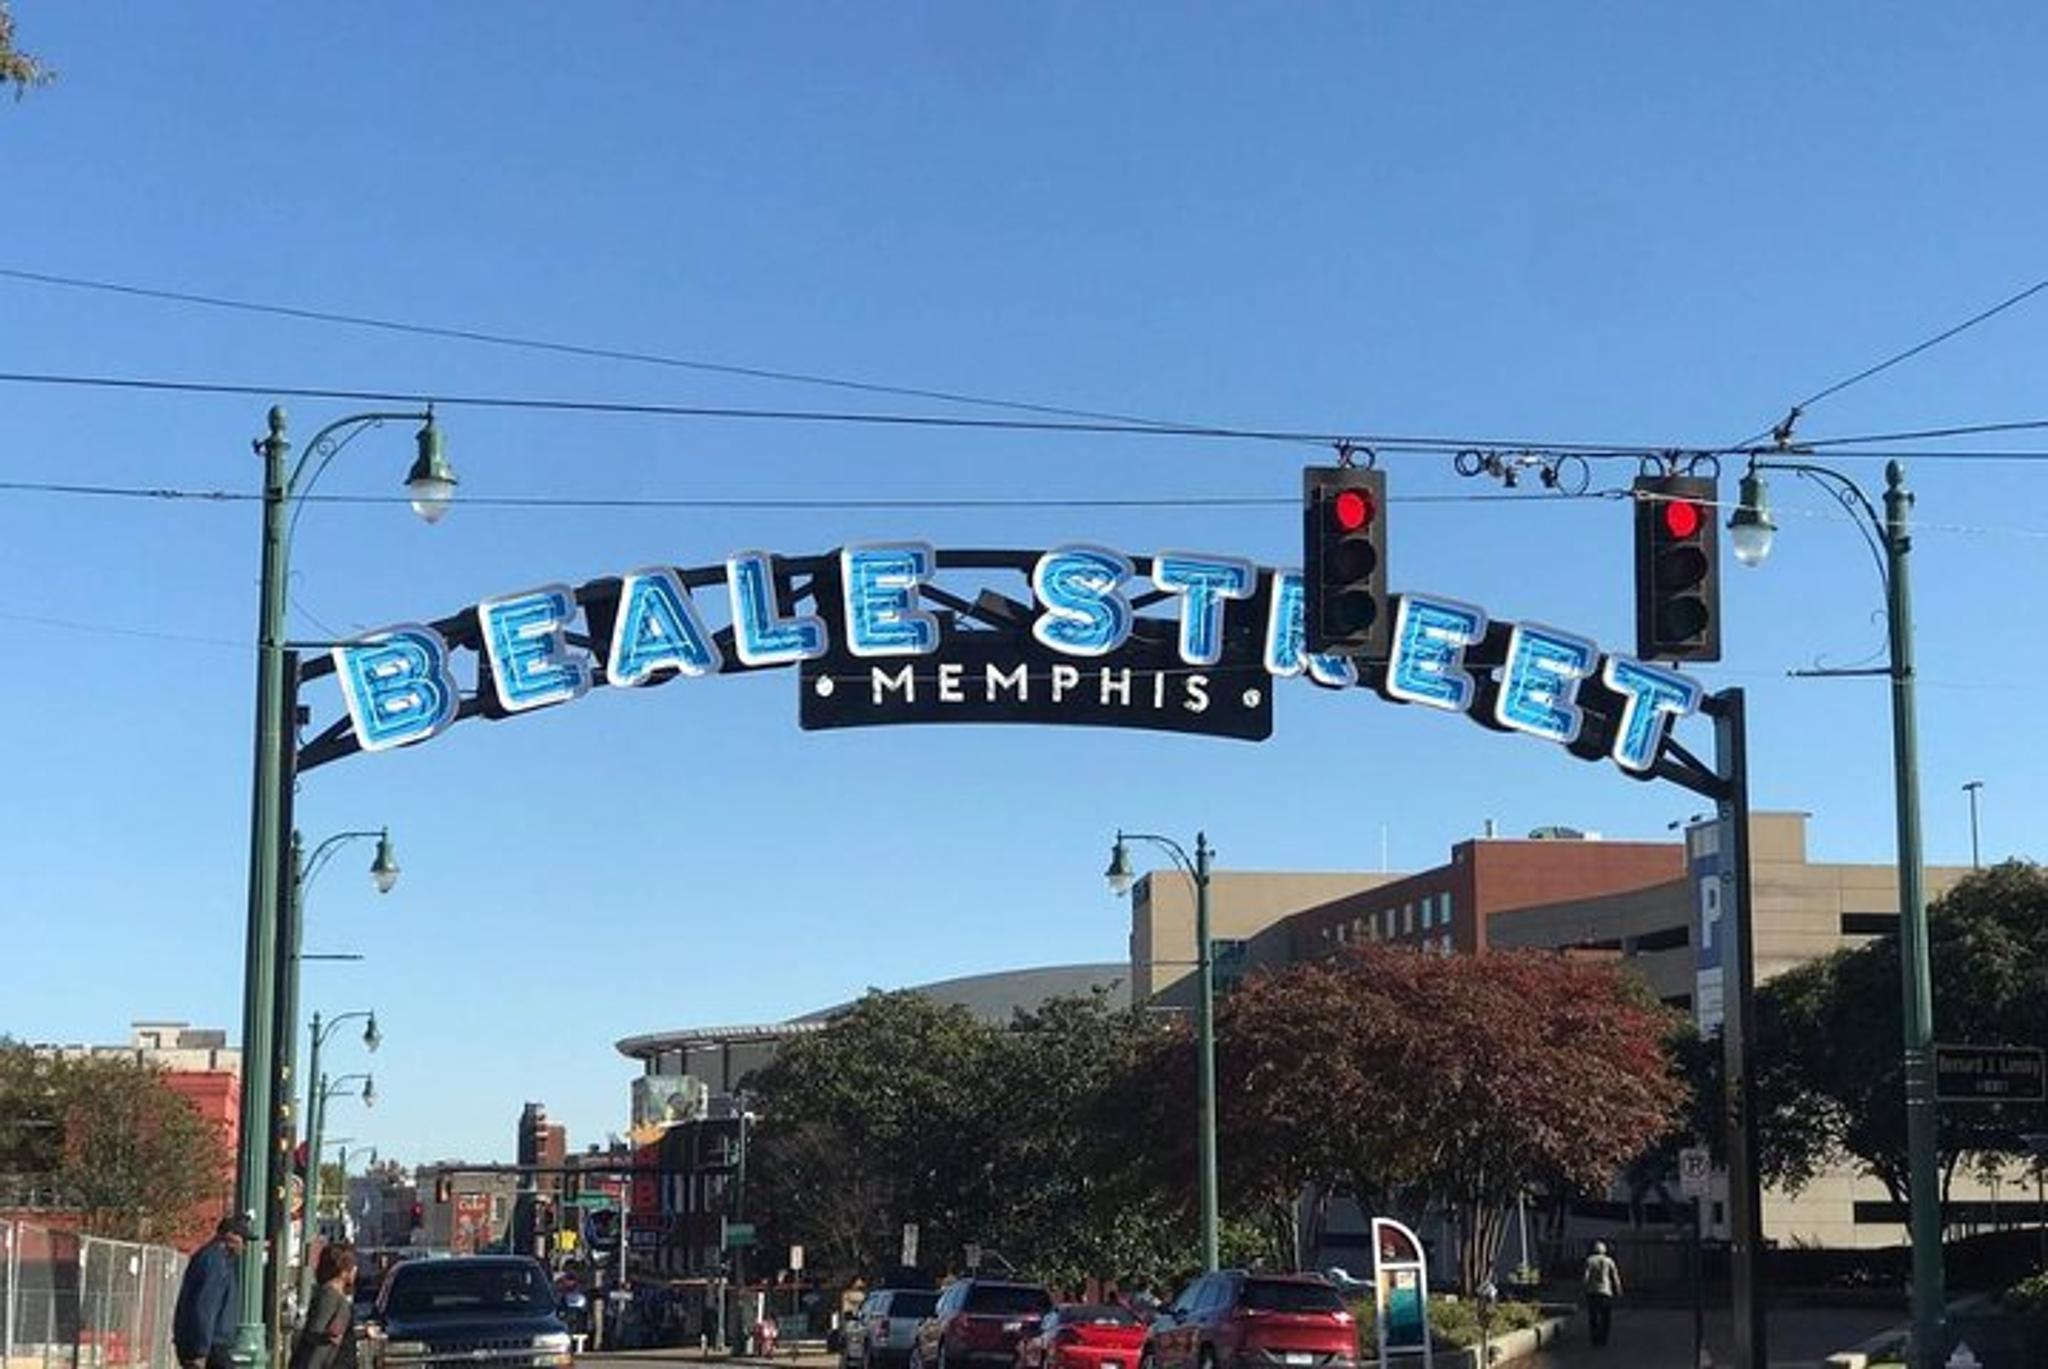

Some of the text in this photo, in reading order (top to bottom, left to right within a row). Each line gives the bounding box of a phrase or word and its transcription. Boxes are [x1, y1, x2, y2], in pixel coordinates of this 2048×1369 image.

[333, 541, 940, 751] BEALE
[872, 663, 1209, 712] MEMPHIS
[1702, 875, 1722, 948] P
